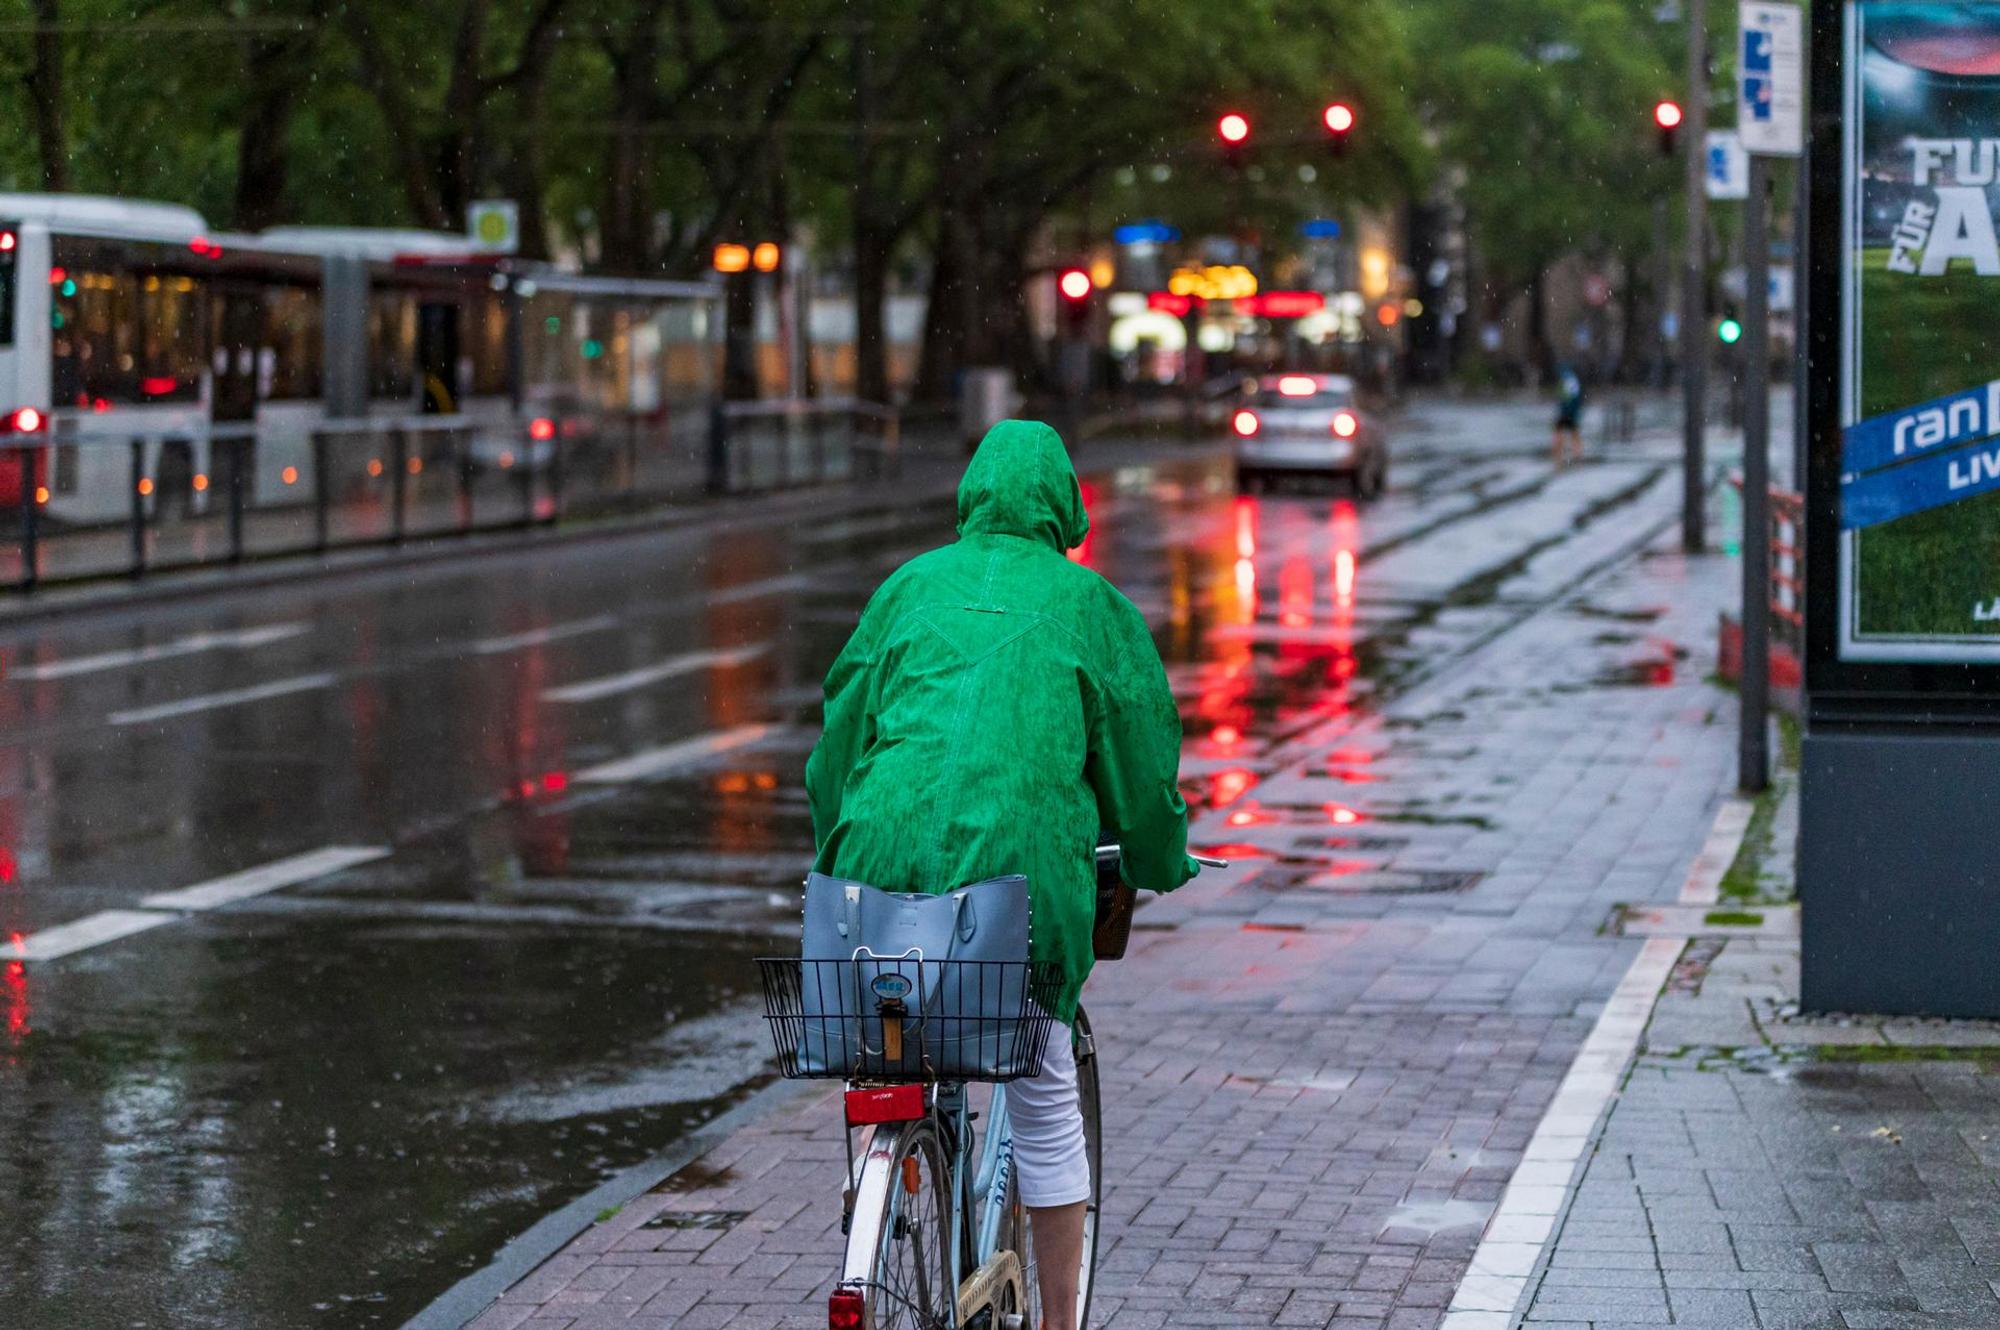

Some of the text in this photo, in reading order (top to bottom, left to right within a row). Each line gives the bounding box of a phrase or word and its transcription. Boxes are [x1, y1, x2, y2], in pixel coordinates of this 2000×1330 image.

[1902, 137, 2000, 186] FU
[1886, 185, 2000, 276] FÜR A
[1893, 397, 1981, 455] ran
